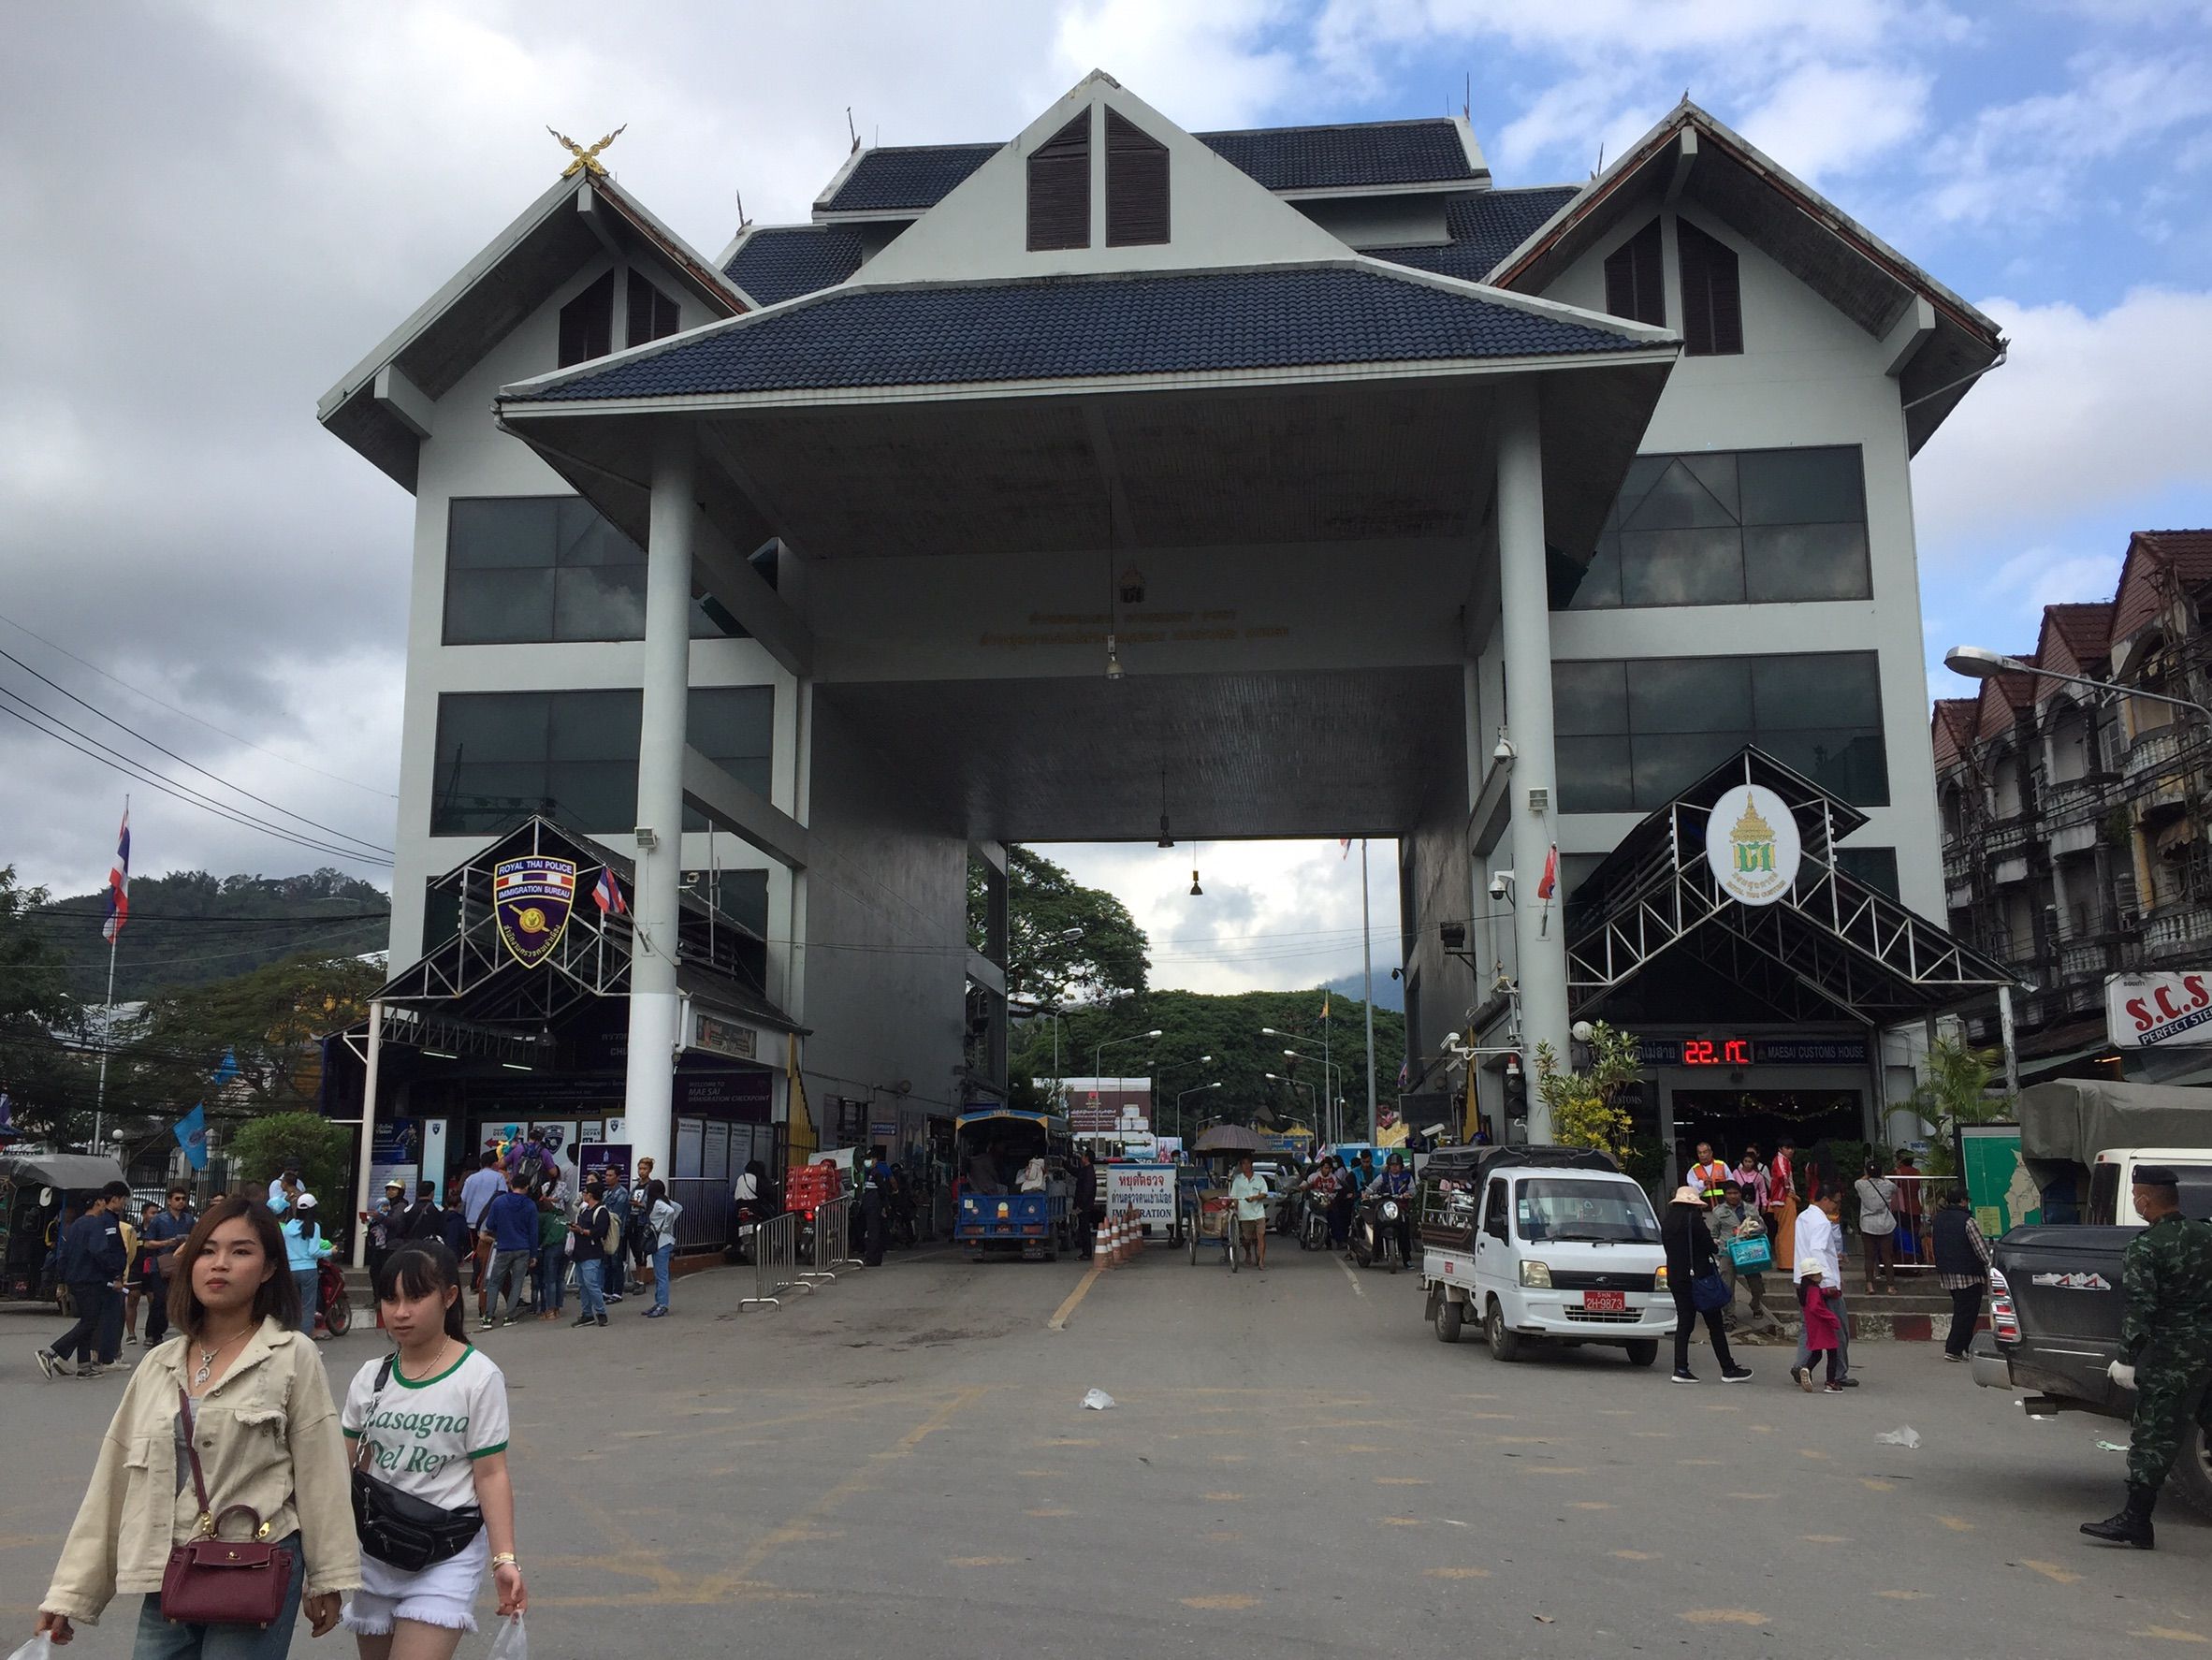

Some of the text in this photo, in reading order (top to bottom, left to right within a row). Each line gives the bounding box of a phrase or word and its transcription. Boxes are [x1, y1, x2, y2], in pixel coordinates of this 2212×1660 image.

[499, 860, 573, 875] ROYAL THAI POLICE
[499, 885, 570, 899] IMMIGRATION BUREAU
[2141, 1018, 2189, 1045] PERFECT
[1768, 1045, 1865, 1058] MAESAI CUSTOMS HOUSE
[689, 1087, 720, 1096] MAE SAI
[1118, 1174, 1165, 1191] หยุดตรวจ
[1112, 1188, 1172, 1205] ด่านตรวจคนเข้าเมือง
[1112, 1208, 1172, 1218] IMRATION
[1586, 1297, 1623, 1310] 2H-9873
[404, 1446, 456, 1479] Rey
